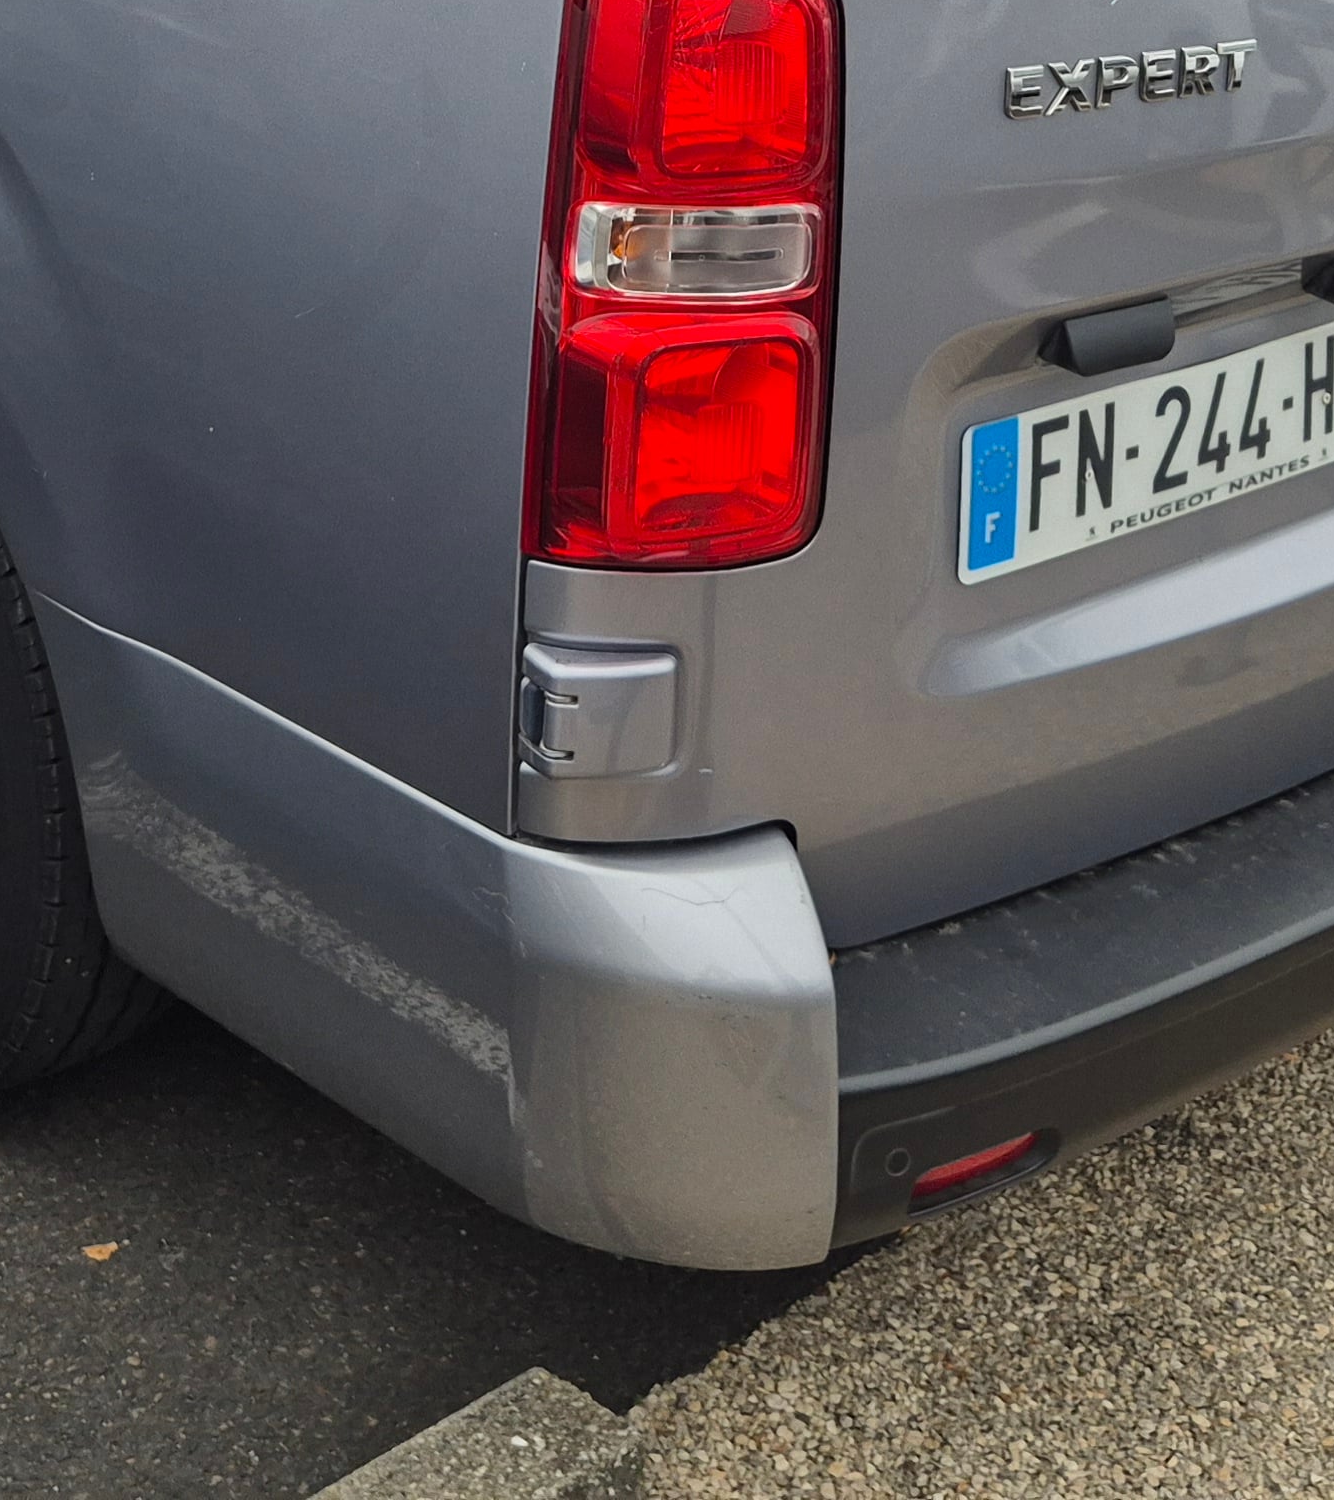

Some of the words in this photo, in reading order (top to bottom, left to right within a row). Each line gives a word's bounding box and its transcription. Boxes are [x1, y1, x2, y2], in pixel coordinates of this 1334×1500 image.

[1004, 38, 1258, 120] EXPERT
[984, 510, 1002, 544] F
[1109, 486, 1218, 534] PEUGEOT
[1227, 454, 1311, 494] NANTES
